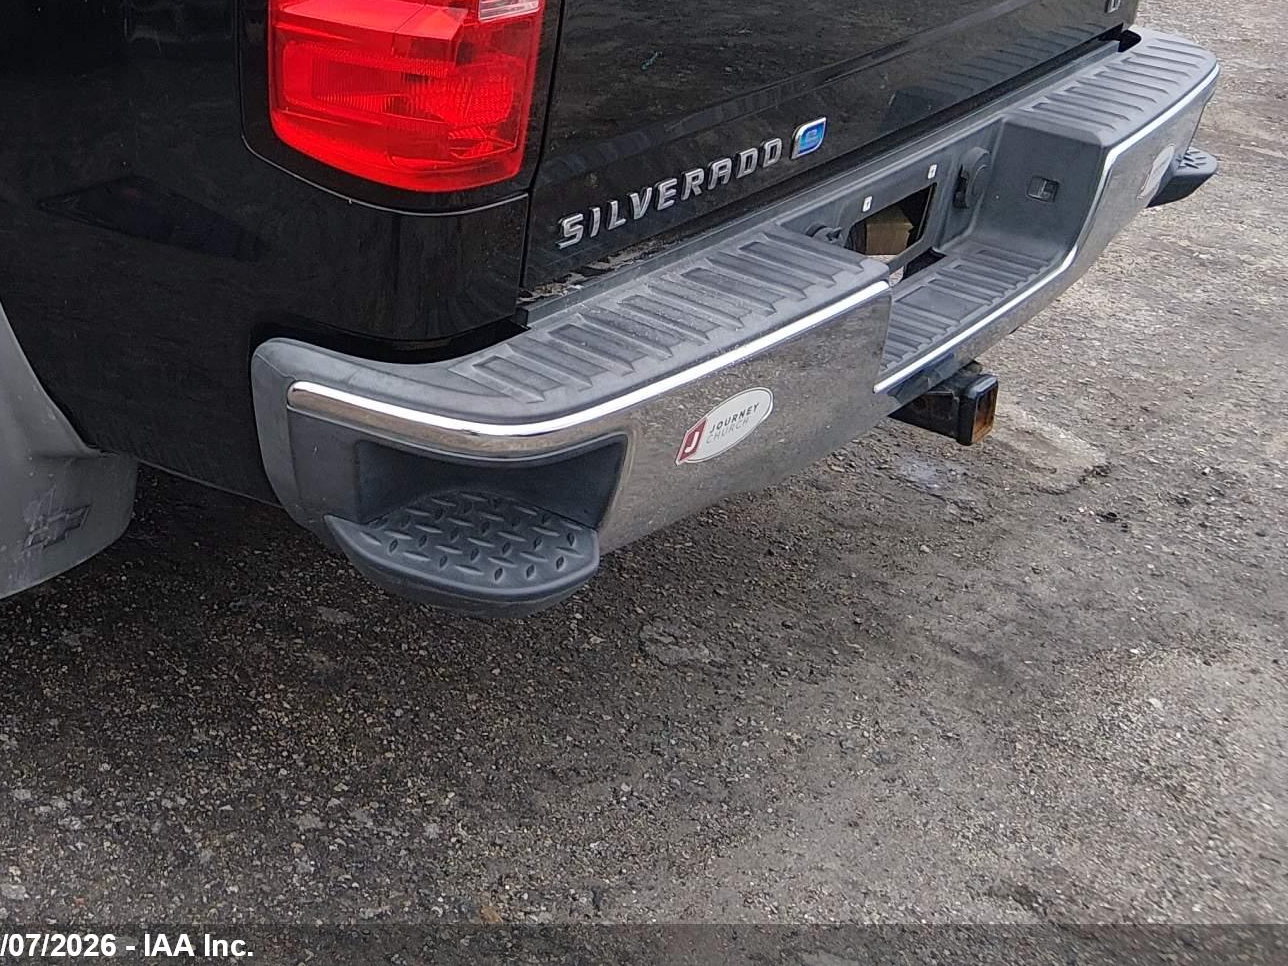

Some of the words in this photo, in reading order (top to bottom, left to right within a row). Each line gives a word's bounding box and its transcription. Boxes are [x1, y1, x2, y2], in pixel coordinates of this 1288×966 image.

[556, 137, 783, 249] SILVERADO
[706, 416, 750, 444] CHURCH
[710, 402, 760, 434] JOURNEY
[684, 431, 700, 453] J
